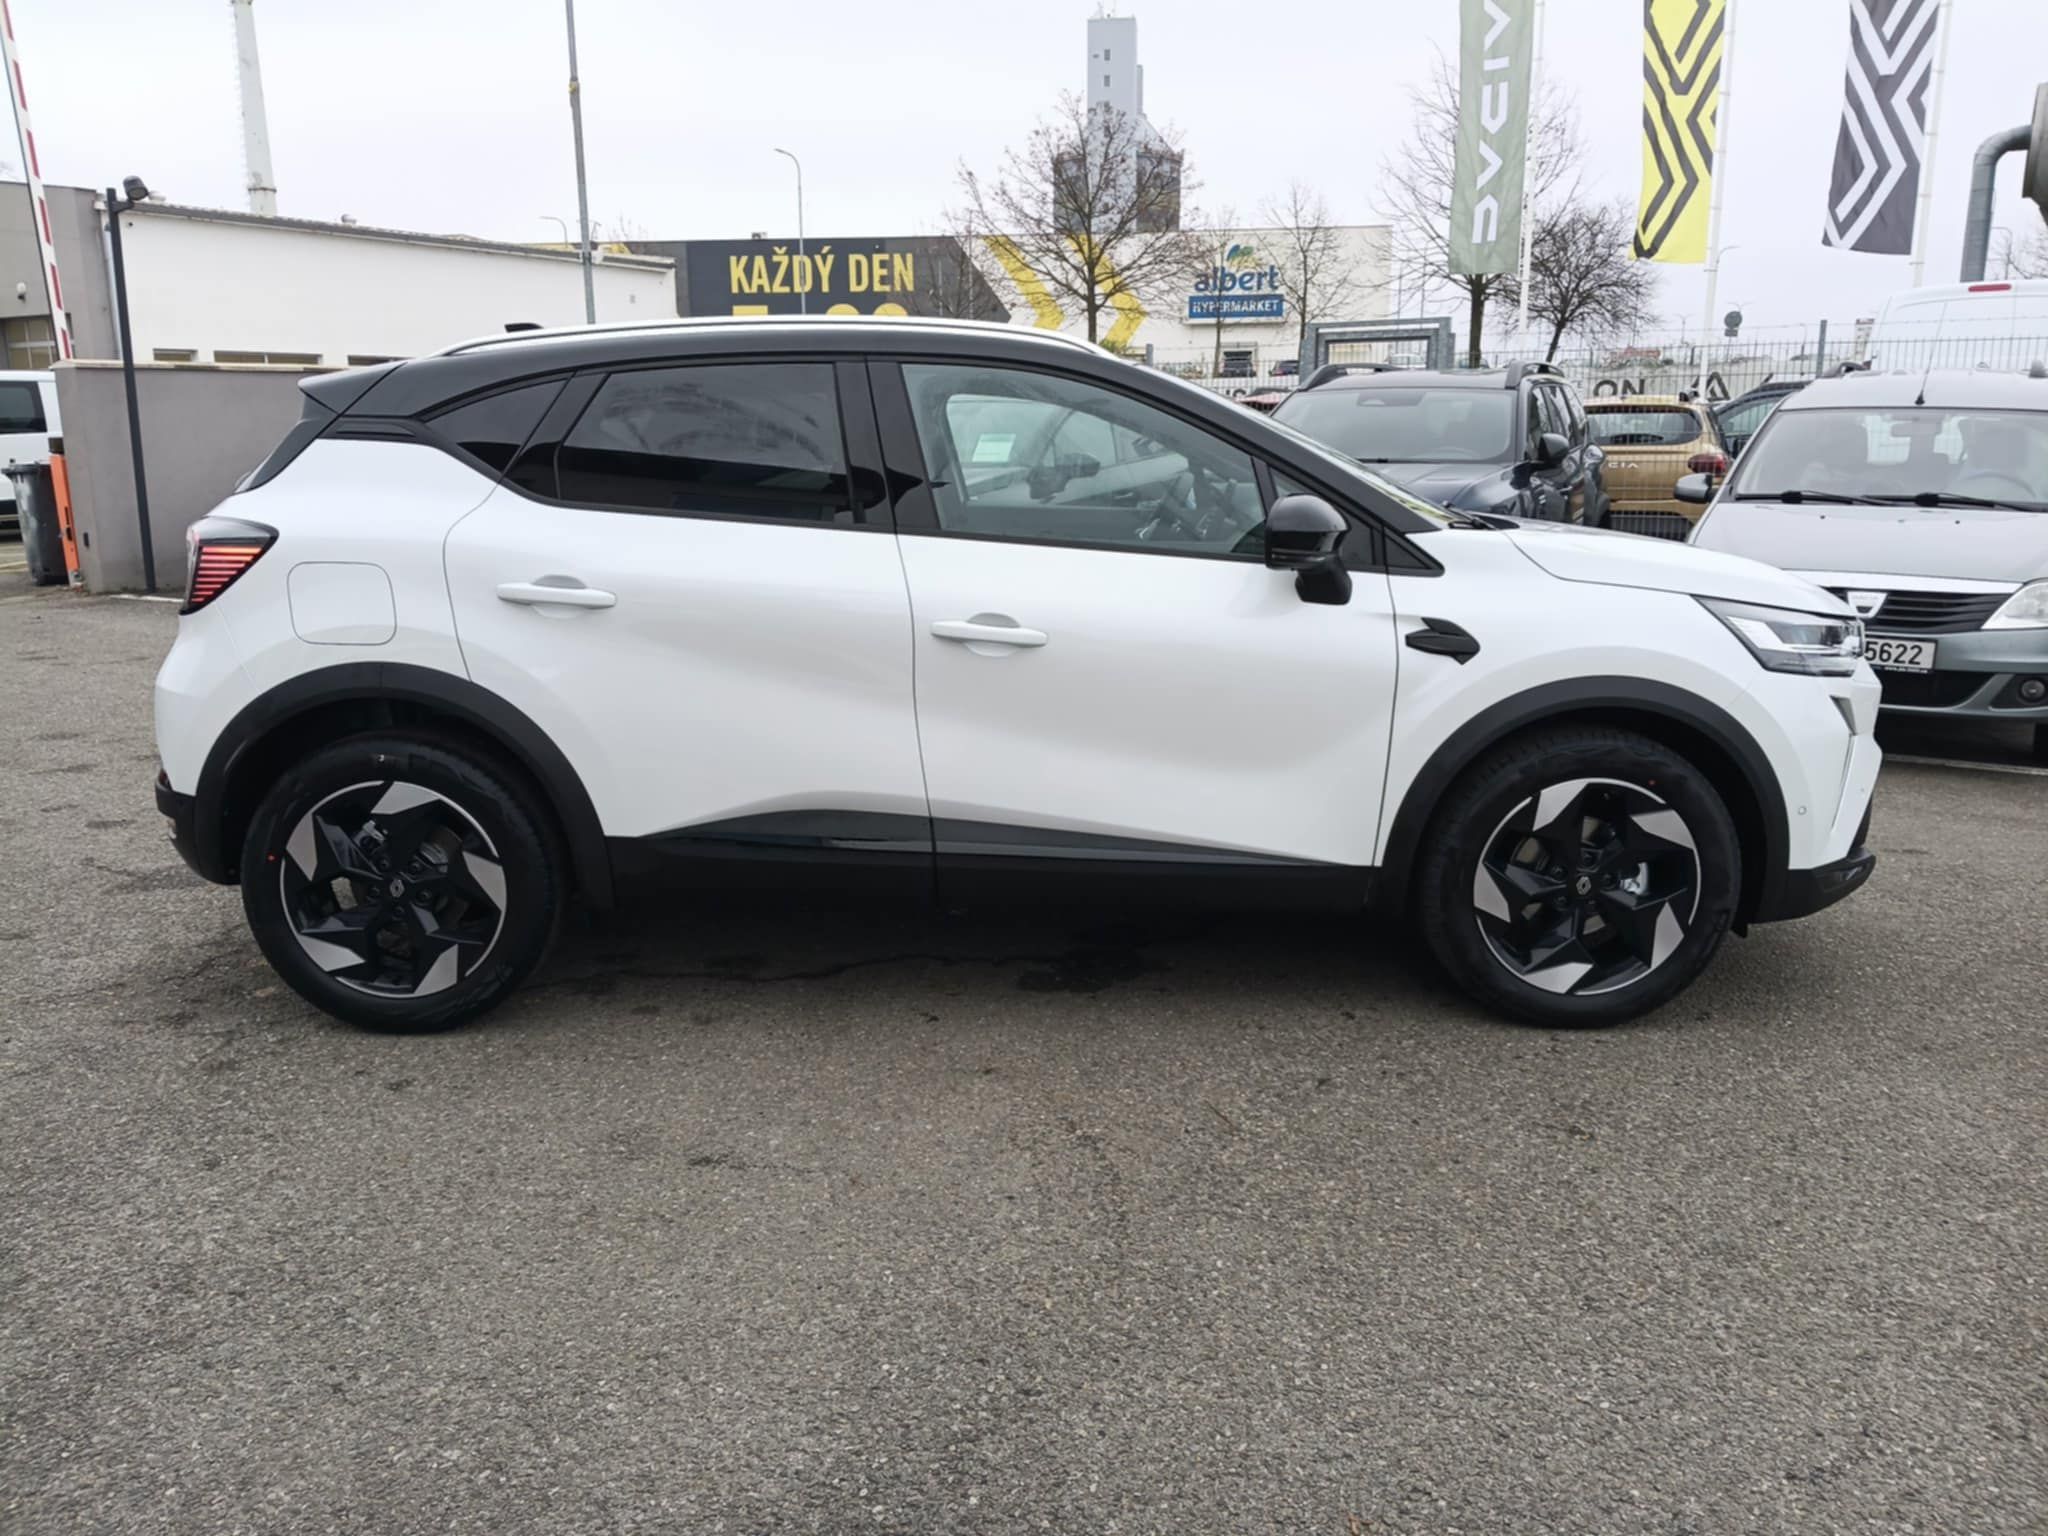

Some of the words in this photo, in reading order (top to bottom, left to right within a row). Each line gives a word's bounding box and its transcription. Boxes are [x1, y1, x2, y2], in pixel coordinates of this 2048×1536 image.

[729, 246, 835, 294] KAŽDÝ
[848, 253, 914, 292] DEN
[1194, 265, 1279, 292] albert
[1192, 300, 1279, 313] HYPERMARKET
[1864, 641, 1922, 665] 5622
